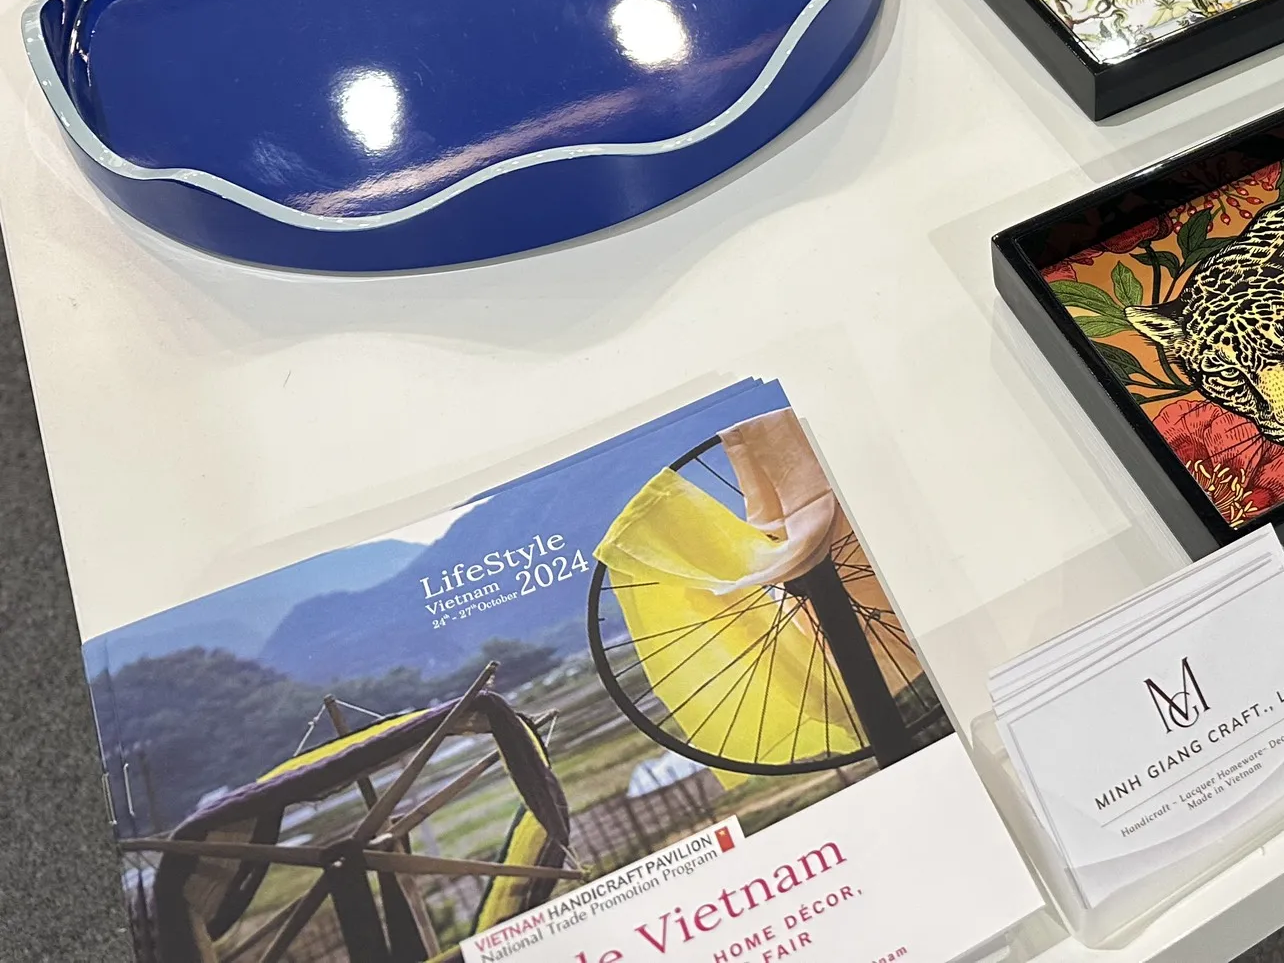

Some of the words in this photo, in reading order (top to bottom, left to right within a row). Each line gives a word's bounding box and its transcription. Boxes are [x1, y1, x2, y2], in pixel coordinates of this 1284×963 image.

[420, 533, 565, 599] LifeStyle
[515, 549, 590, 596] 2024
[425, 582, 500, 615] Vietnam
[477, 591, 517, 612] October
[1094, 774, 1142, 810] MINH
[1147, 739, 1203, 779] GIANG
[1187, 792, 1213, 811] Made
[1215, 784, 1225, 795] in
[1224, 762, 1263, 791] Vietnam
[1120, 803, 1171, 837] Handicraft
[1178, 777, 1216, 803] Lacquer
[474, 912, 546, 952] VIETNAM
[546, 865, 646, 920] HANDICRAFT
[645, 834, 713, 878] PAVILION
[480, 930, 544, 963] National
[547, 910, 588, 936] Trade
[590, 876, 660, 917] Promotion
[662, 849, 718, 882] Program
[633, 841, 847, 955] Vietnam
[713, 925, 776, 963] HOME
[762, 932, 812, 963] FAIR
